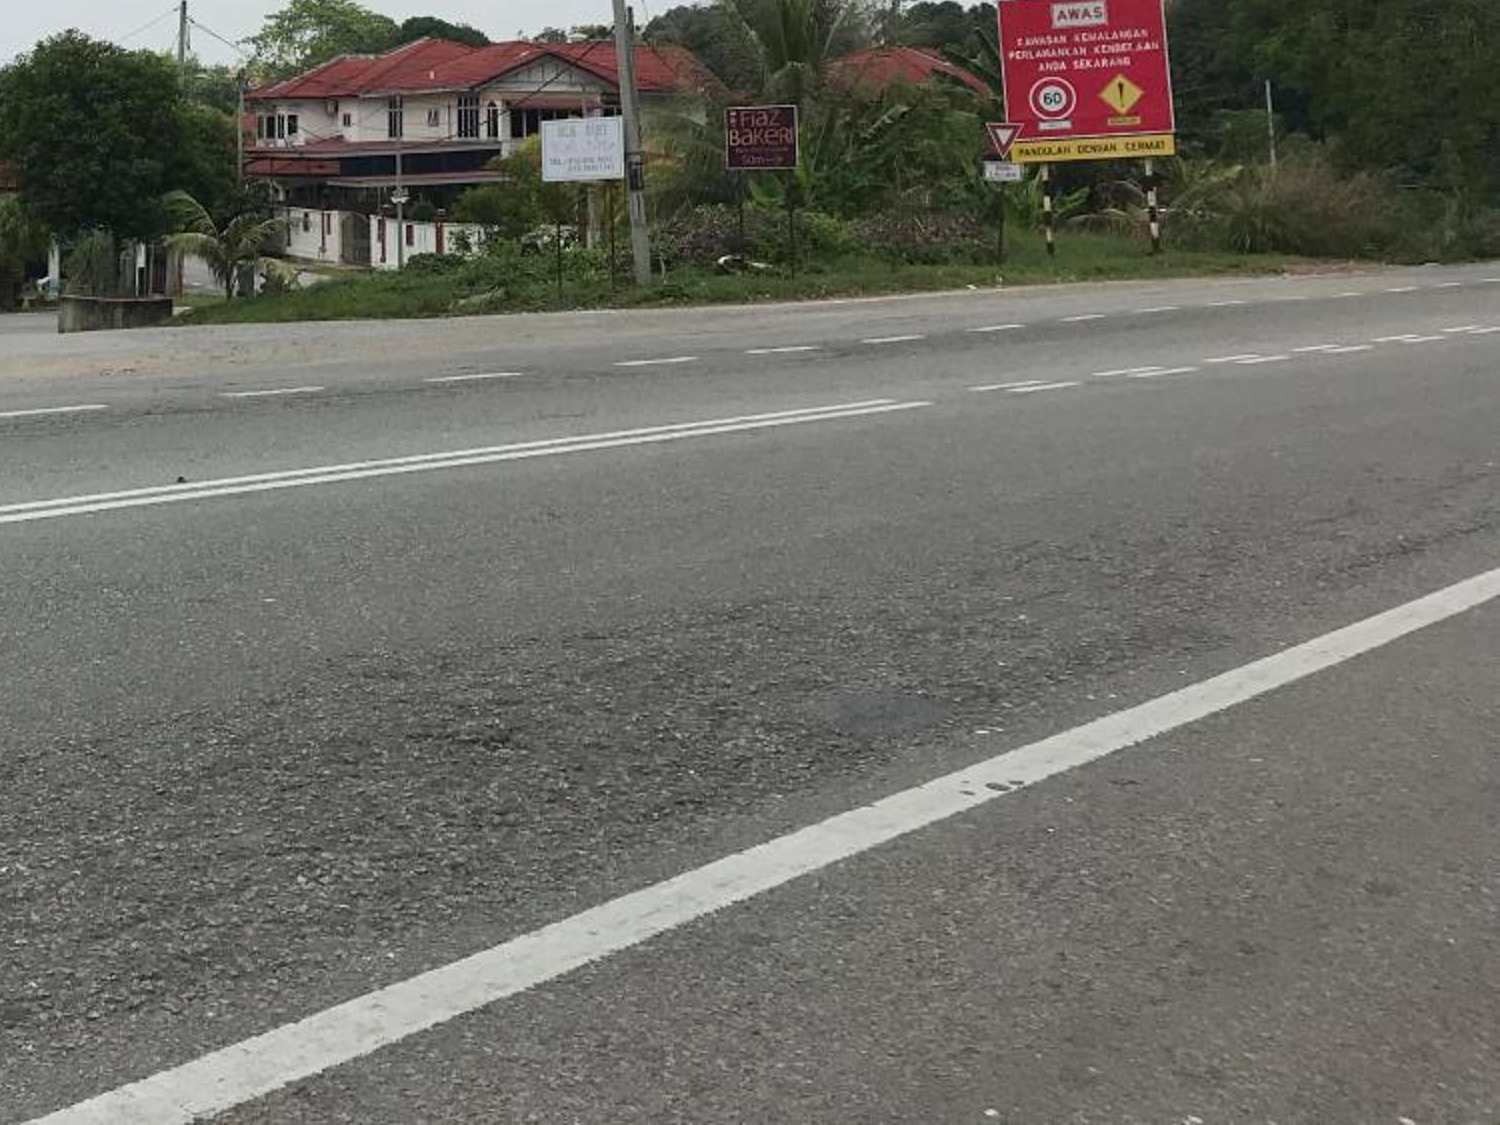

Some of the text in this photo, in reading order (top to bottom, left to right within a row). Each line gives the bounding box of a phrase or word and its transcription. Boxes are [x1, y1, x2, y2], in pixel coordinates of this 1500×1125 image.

[1057, 6, 1103, 22] AWAS
[1072, 56, 1132, 70] SEKARANG
[1043, 91, 1063, 106] 60
